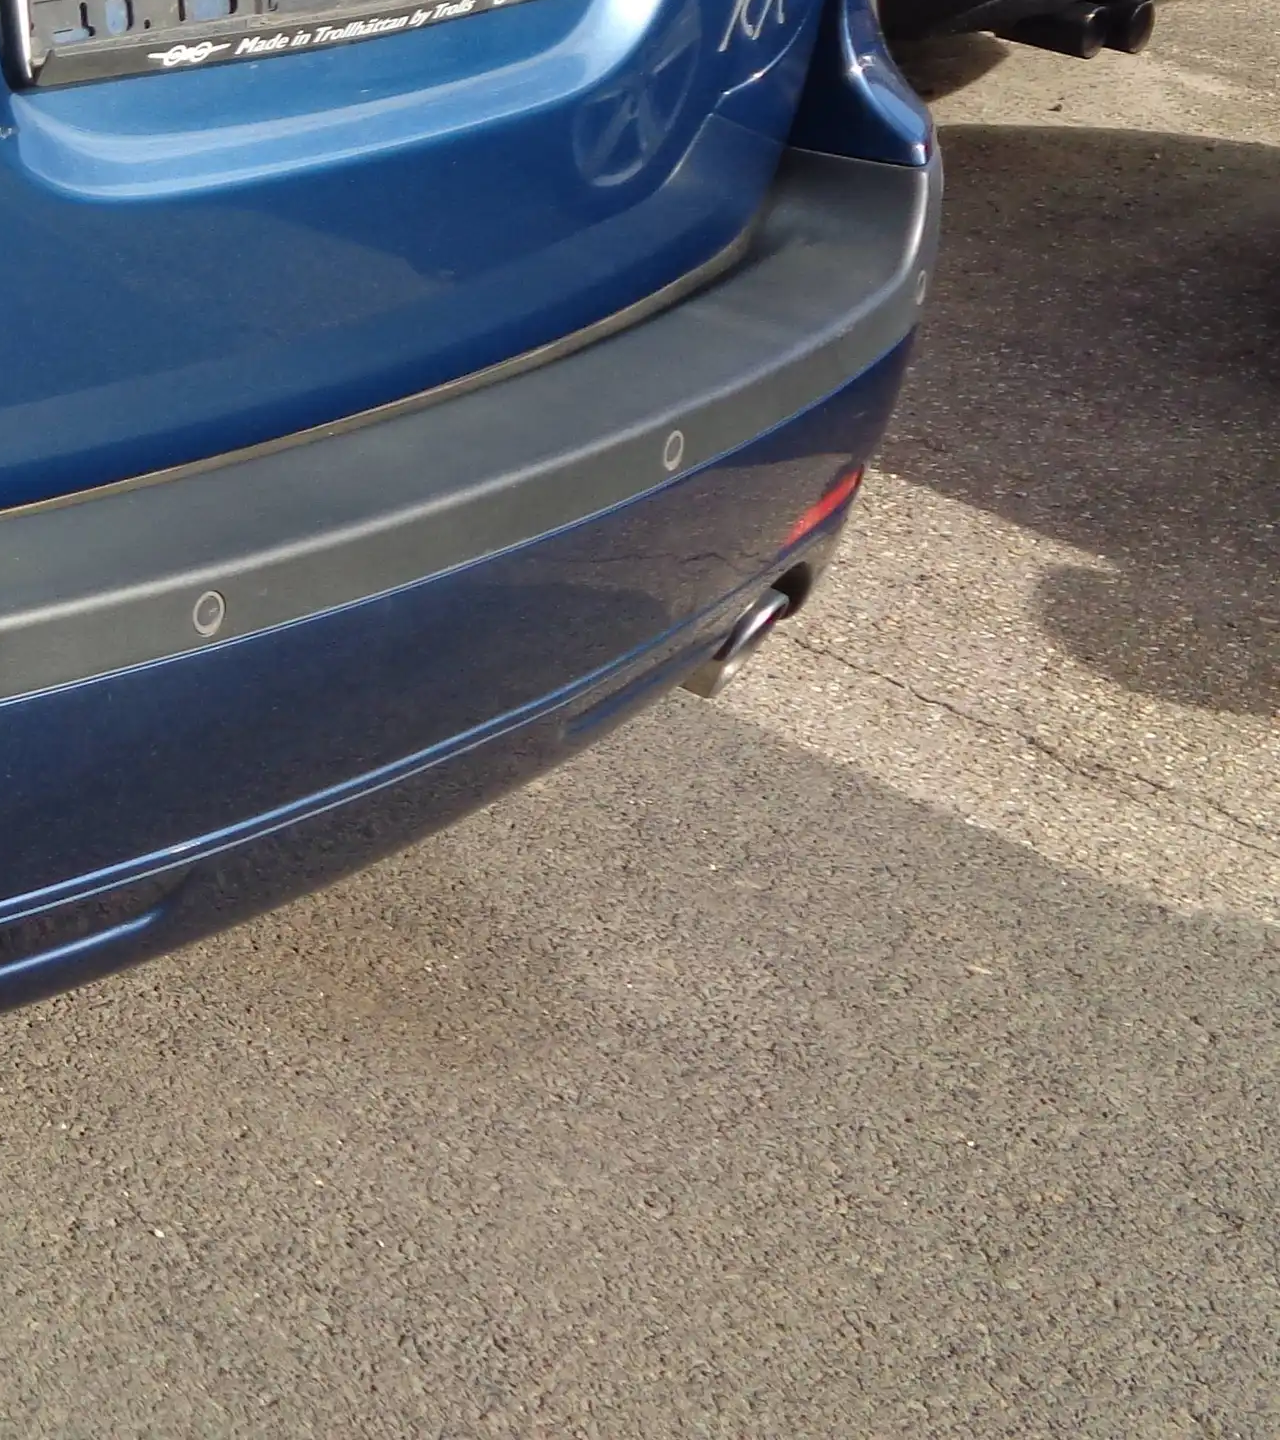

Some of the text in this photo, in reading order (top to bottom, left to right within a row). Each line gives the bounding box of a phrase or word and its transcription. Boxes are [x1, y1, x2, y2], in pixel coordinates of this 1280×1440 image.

[234, 32, 290, 55] Made
[291, 29, 312, 47] in
[312, 14, 410, 44] Trollhättan
[409, 8, 433, 27] by
